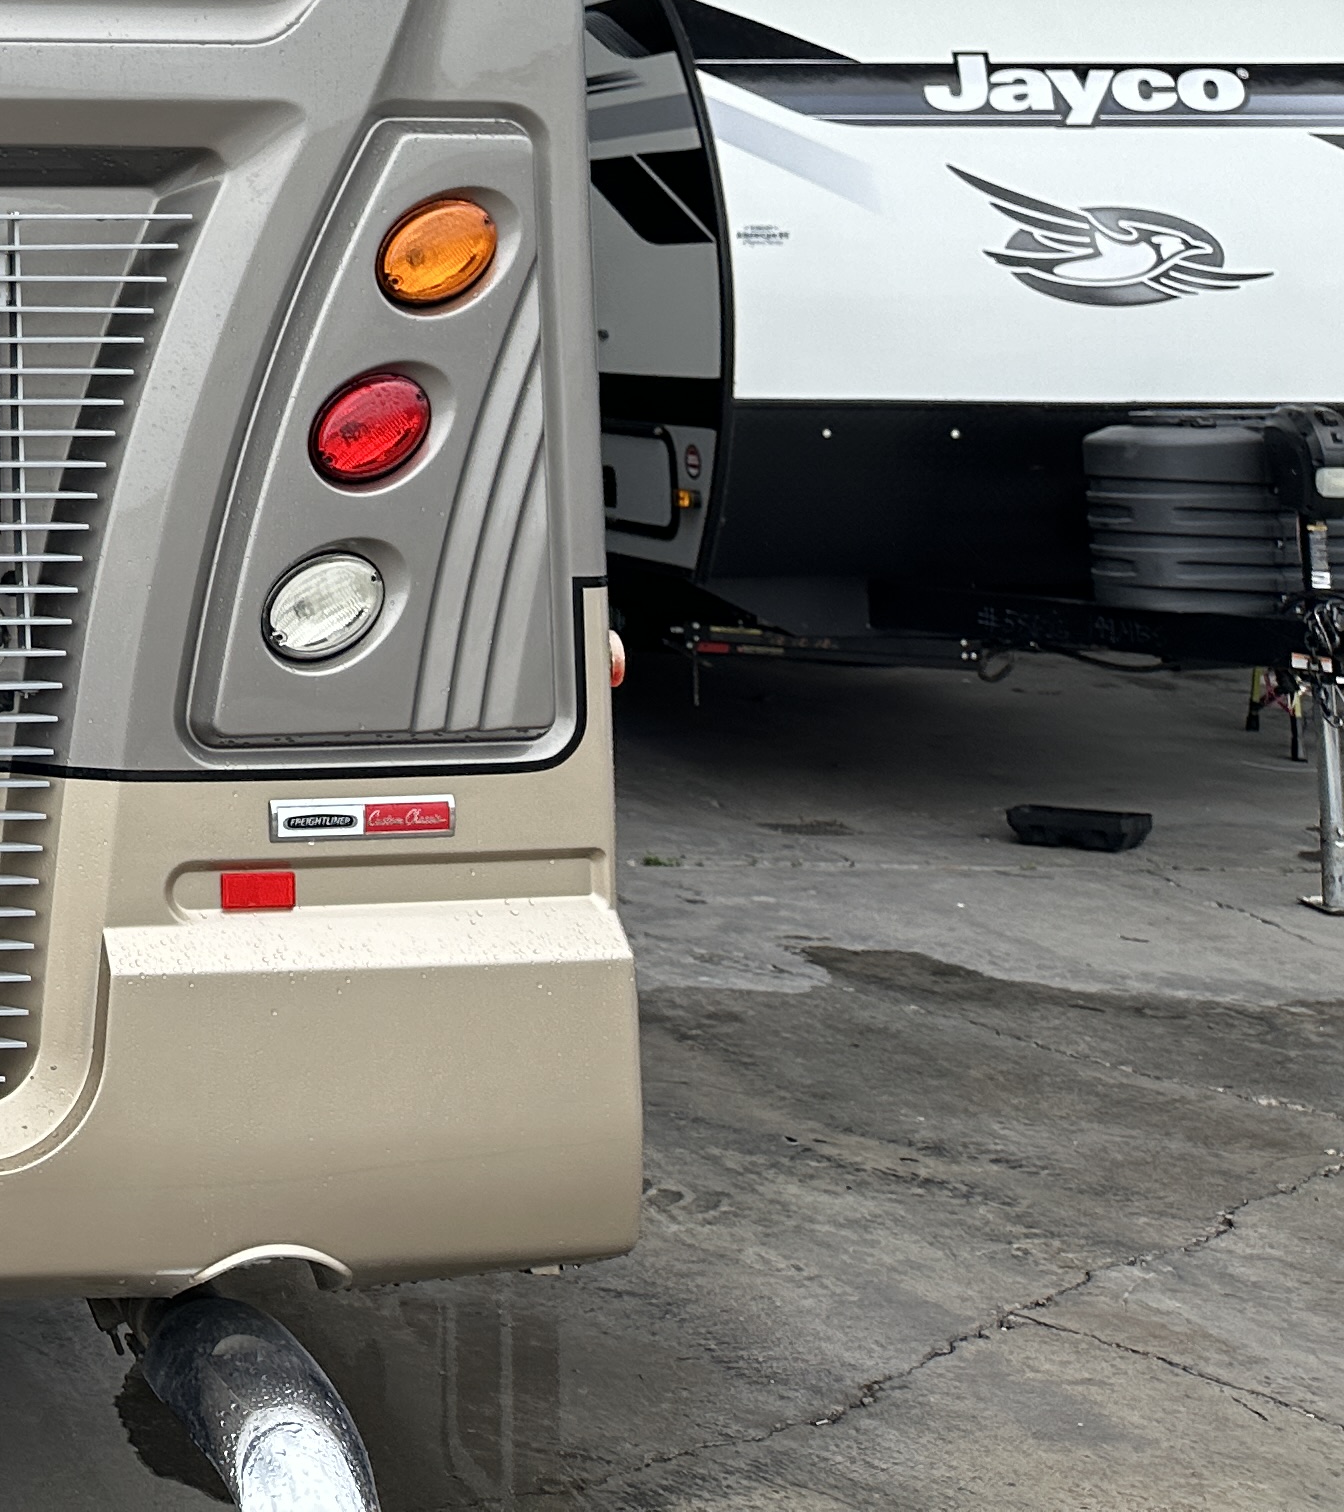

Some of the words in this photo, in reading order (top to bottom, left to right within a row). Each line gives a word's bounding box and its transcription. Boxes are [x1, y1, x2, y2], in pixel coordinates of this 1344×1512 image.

[923, 52, 1246, 126] Jayco
[290, 816, 352, 827] FREIGHTLINER
[368, 810, 404, 826] Custom
[405, 809, 446, 826] Chassis
